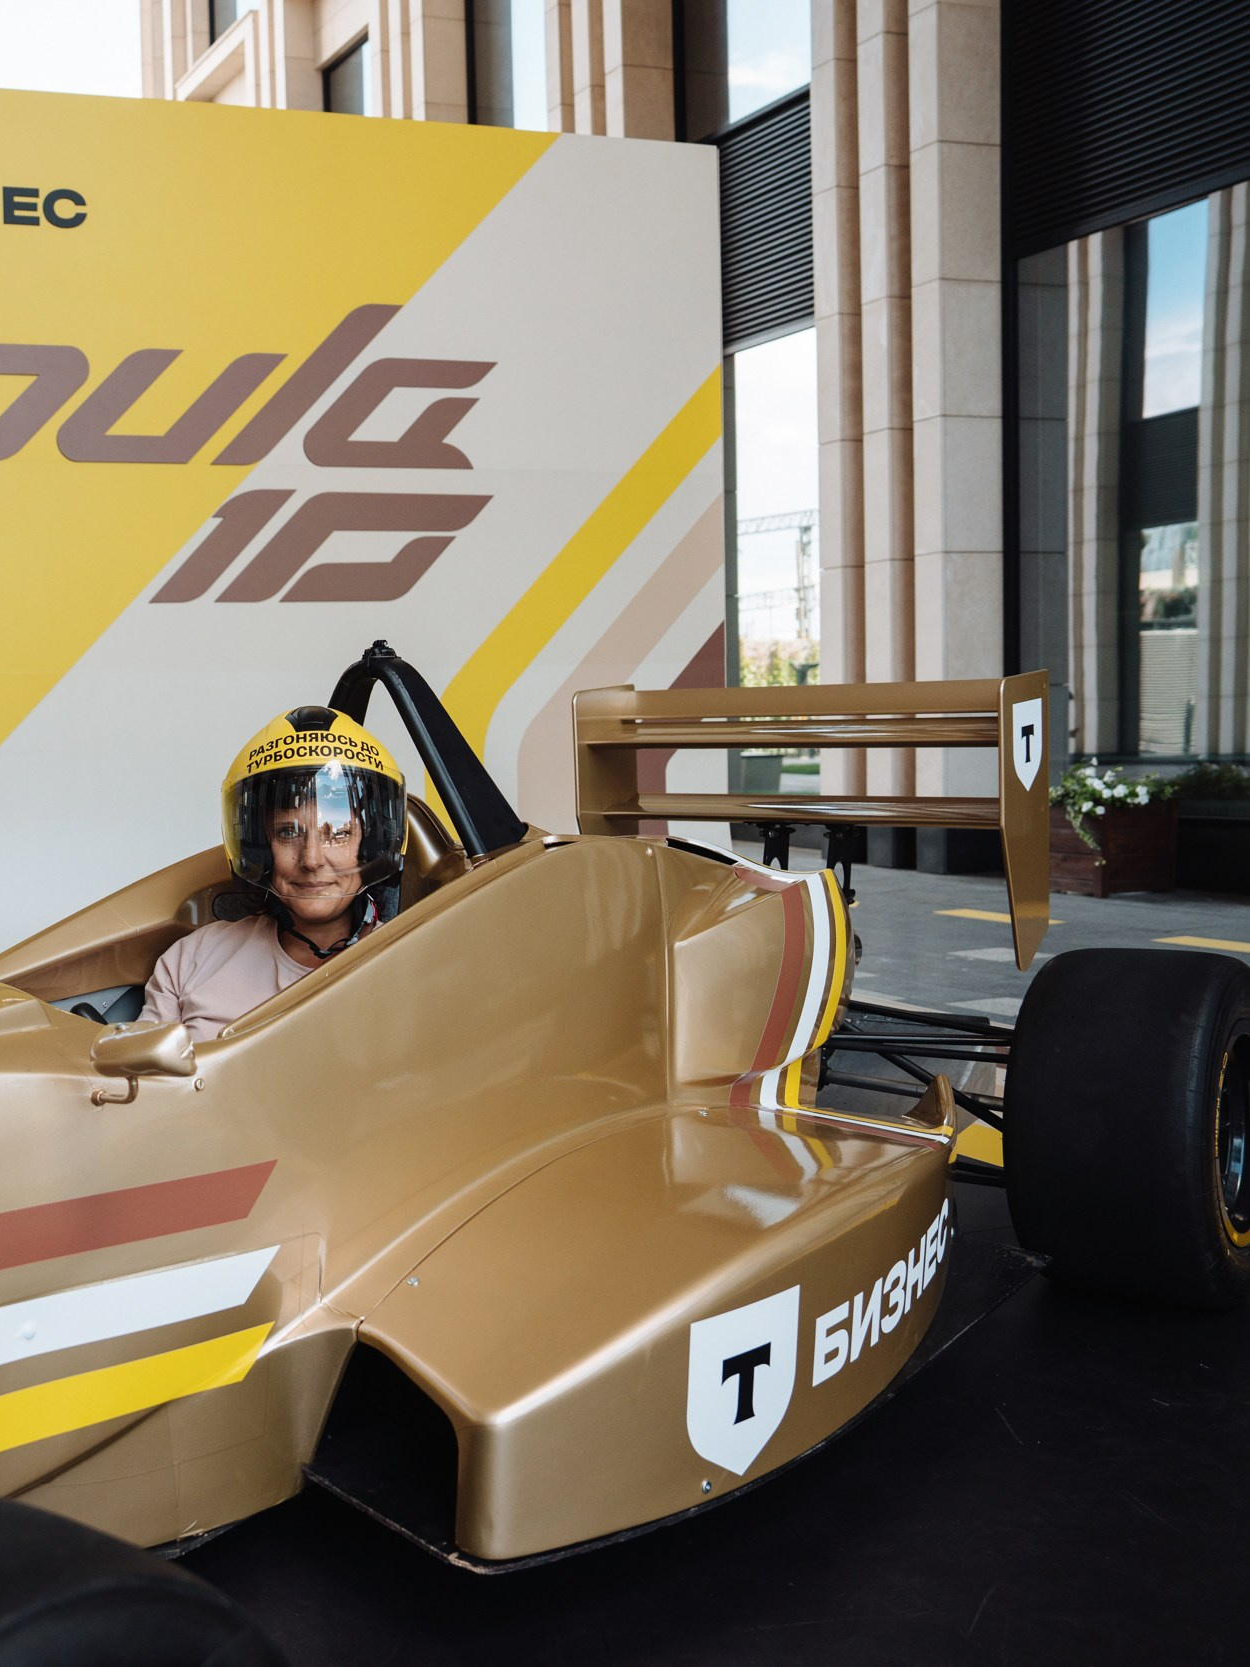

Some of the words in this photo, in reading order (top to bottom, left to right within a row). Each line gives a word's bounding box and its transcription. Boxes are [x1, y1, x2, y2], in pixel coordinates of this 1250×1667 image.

[246, 745, 384, 774] ТУРБОСКОРОСТИ
[248, 732, 358, 761] РАЗГОНЯЮСЬ
[360, 740, 380, 757] ДО
[812, 1197, 949, 1388] БИЗНЕС
